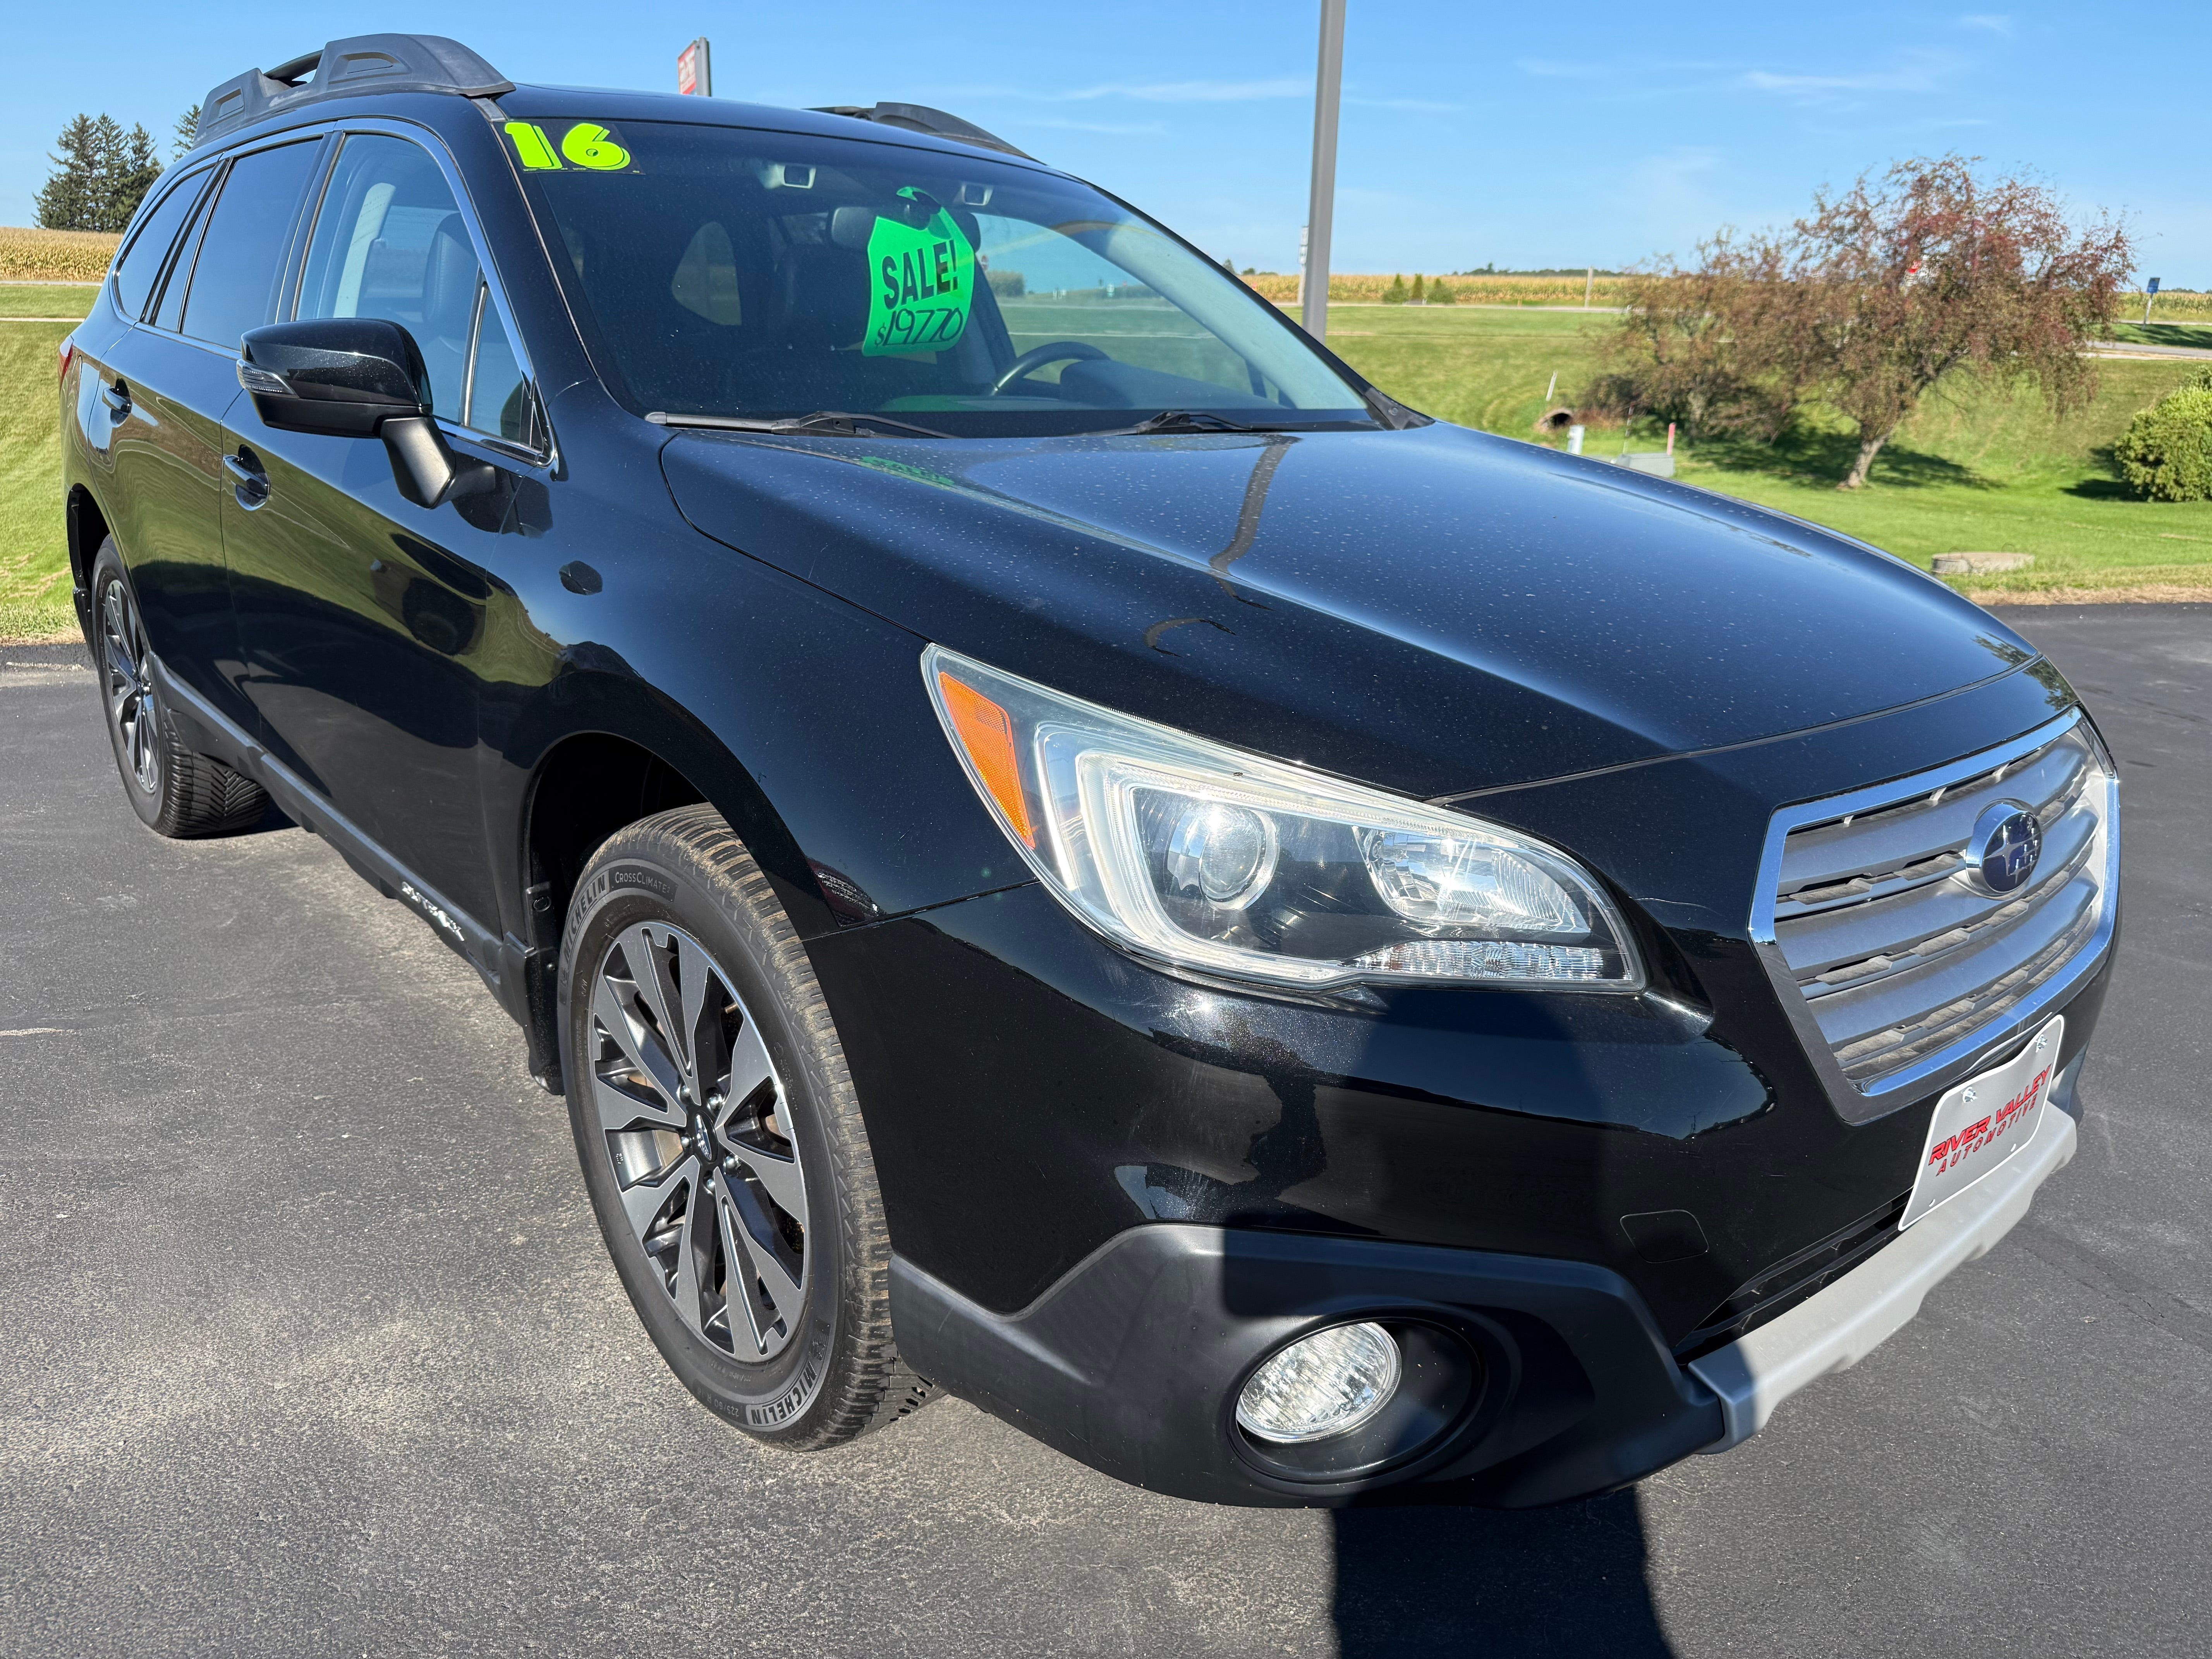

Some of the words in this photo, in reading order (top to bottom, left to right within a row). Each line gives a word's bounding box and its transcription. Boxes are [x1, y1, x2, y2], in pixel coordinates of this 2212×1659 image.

[505, 122, 630, 170] 16
[882, 239, 958, 310] SALE!
[563, 874, 606, 965] MICHELIN
[1928, 1115, 1991, 1166] RIVER
[1996, 1063, 2052, 1124] VALLEY
[1936, 1092, 2038, 1177] AUTOMOTIVE
[750, 1360, 817, 1424] MICHELIN
